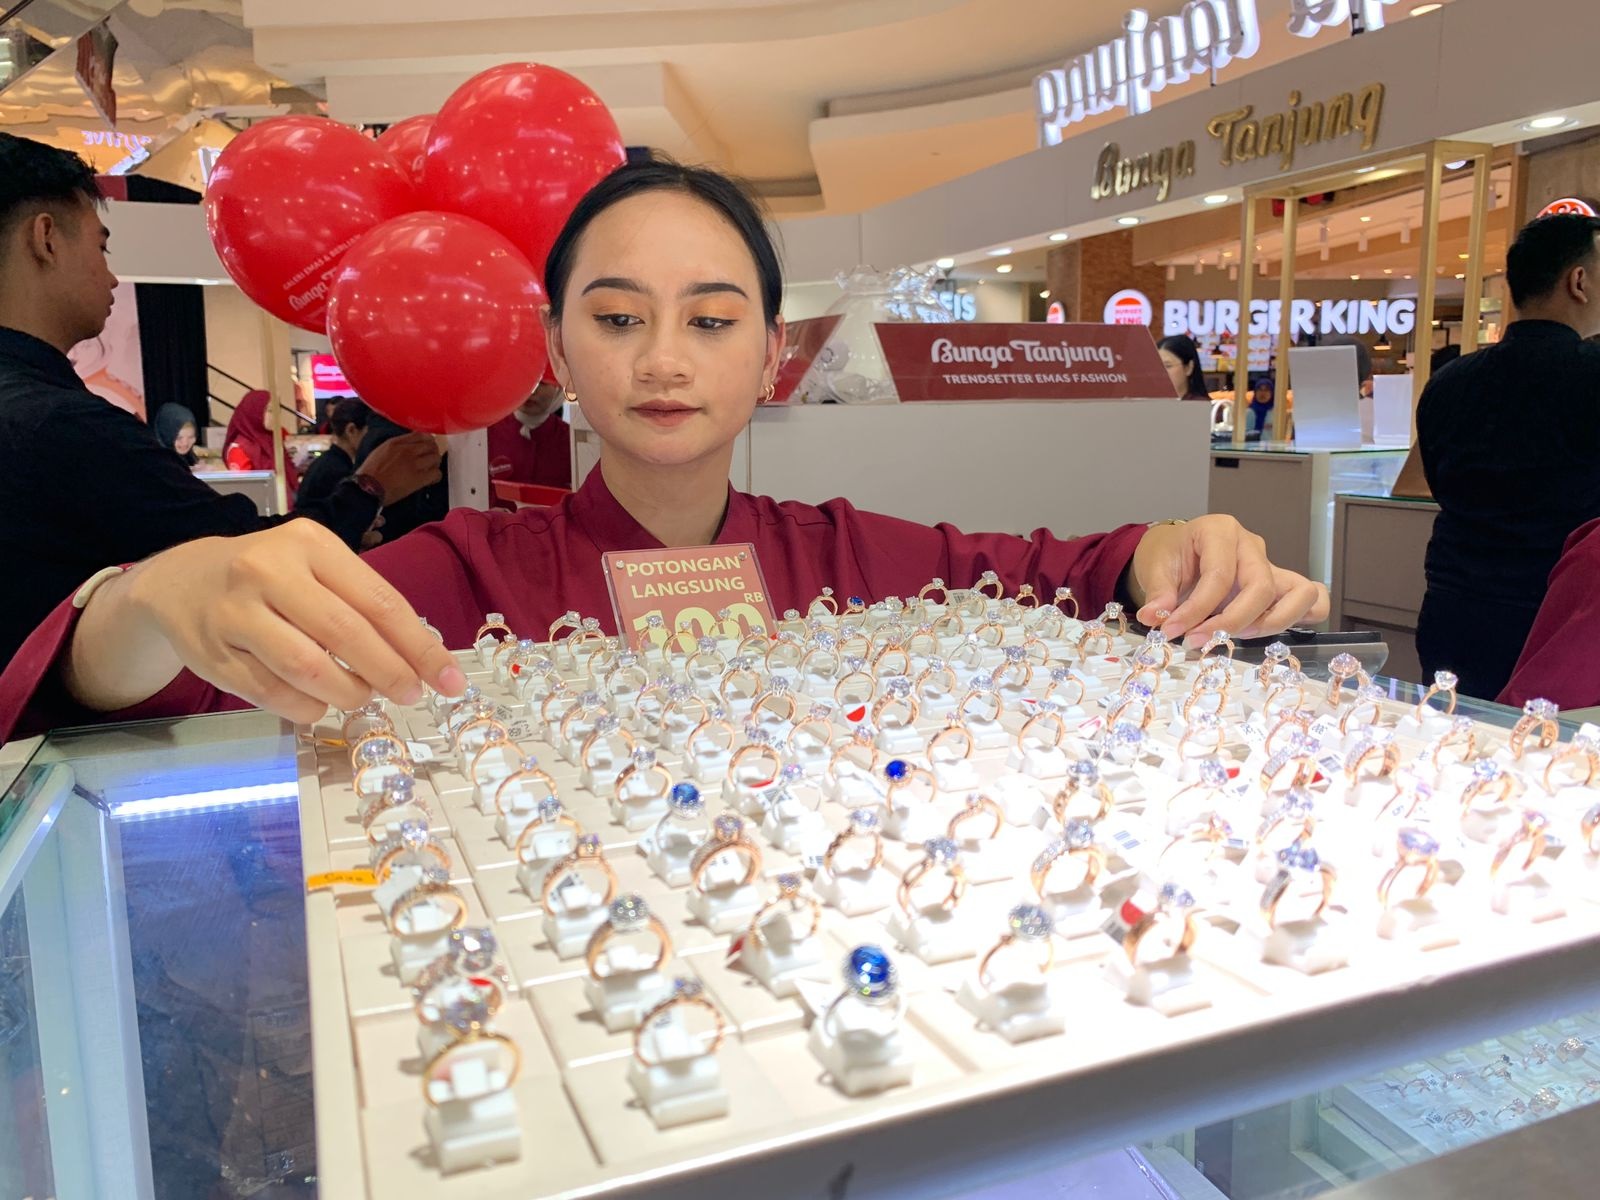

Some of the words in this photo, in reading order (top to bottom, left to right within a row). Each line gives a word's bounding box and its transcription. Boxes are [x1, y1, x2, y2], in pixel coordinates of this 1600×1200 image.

[1090, 141, 1196, 202] Bunga
[1207, 82, 1385, 171] Tanjung
[288, 281, 329, 312] Bunga
[1163, 299, 1315, 336] BURGER
[1320, 299, 1416, 335] KING
[931, 338, 1014, 369] Bunga
[1009, 340, 1115, 369] Tanjung
[942, 373, 1034, 385] TRENDSETTER
[1035, 373, 1071, 384] EMAS
[1072, 373, 1128, 384] FASHION
[625, 555, 741, 578] POTONGAN
[631, 576, 746, 599] LANGSUNG
[632, 602, 769, 657] 100
[743, 591, 765, 603] RB
